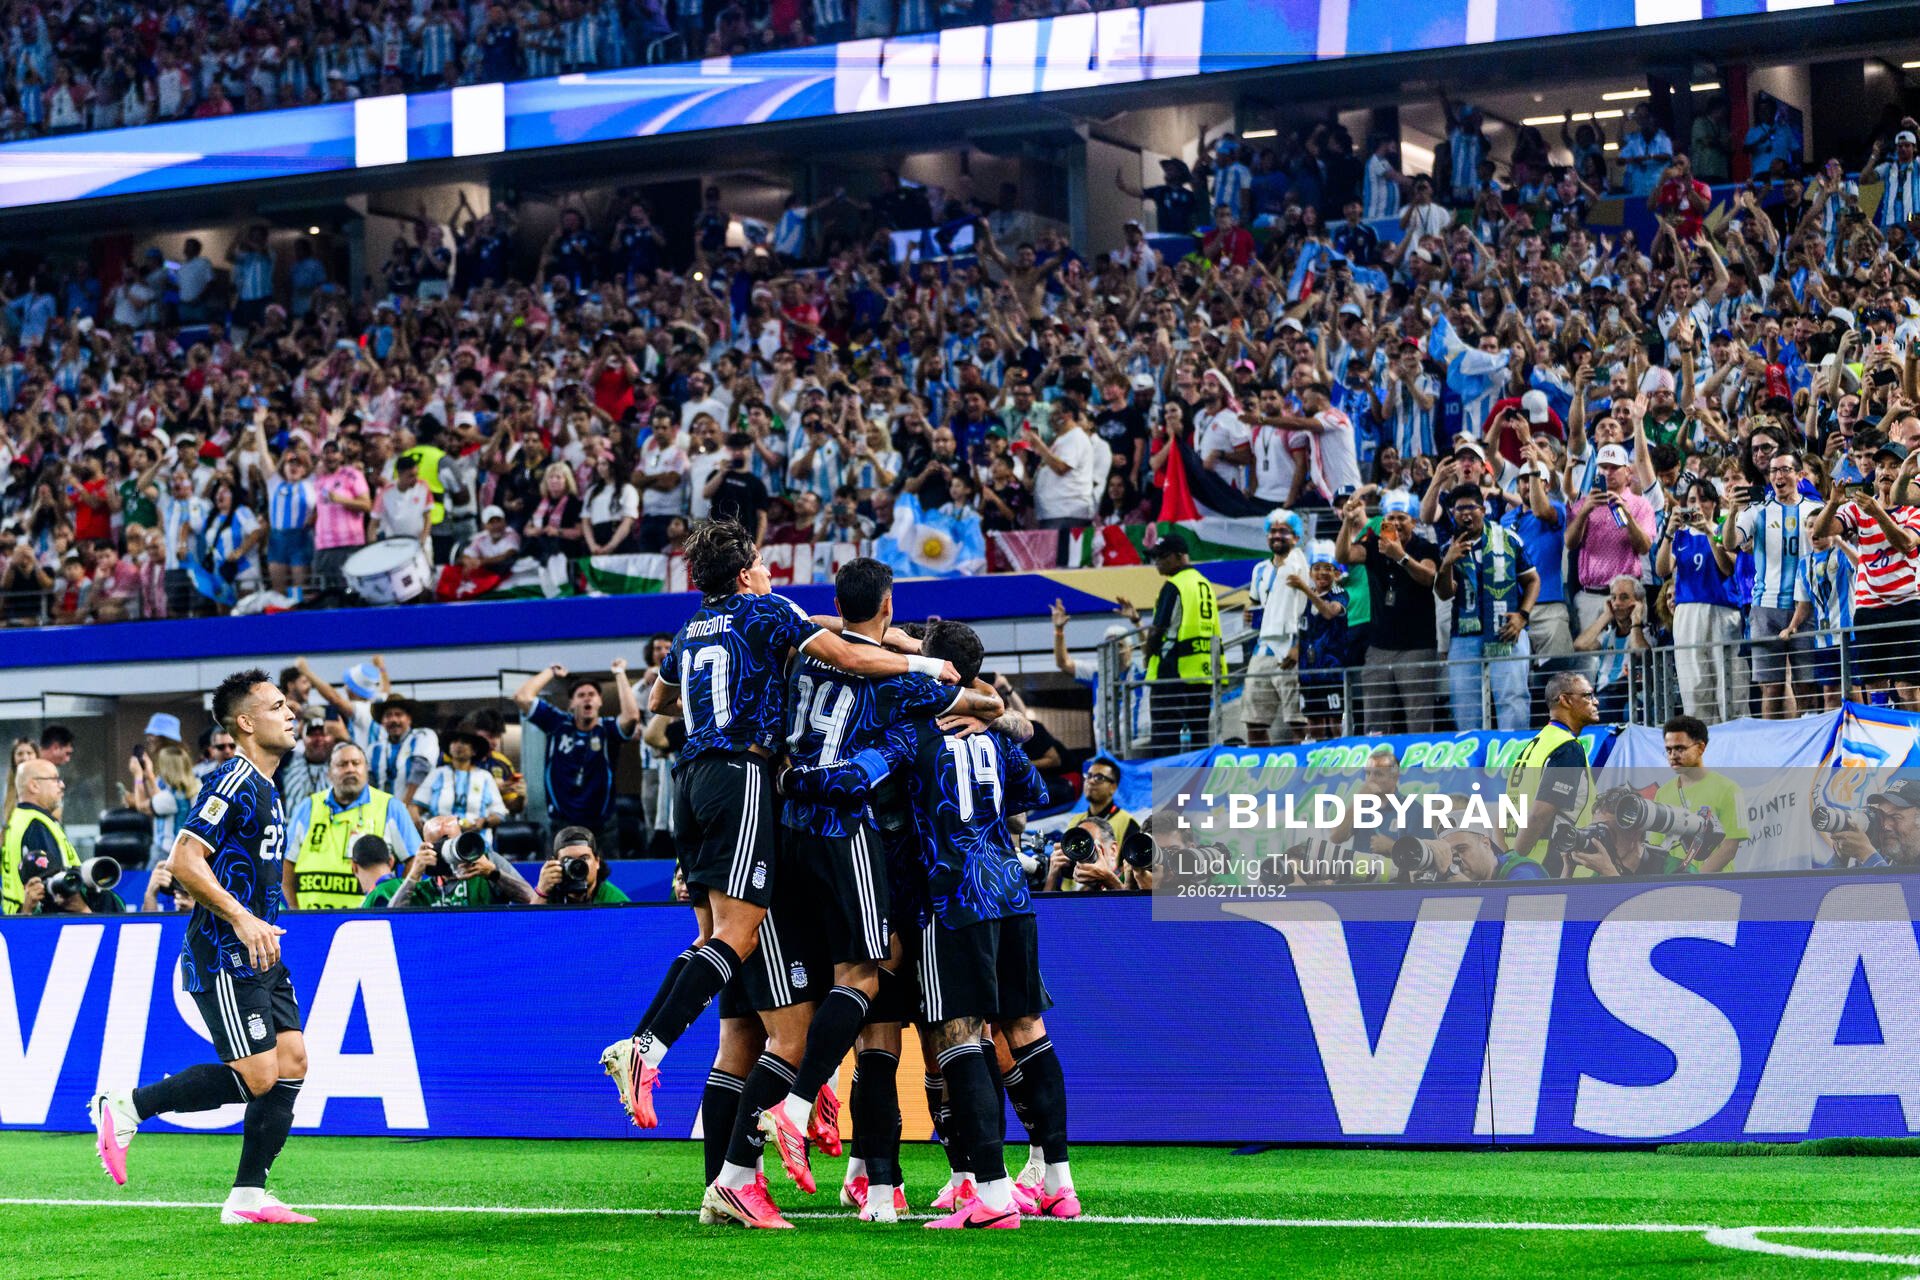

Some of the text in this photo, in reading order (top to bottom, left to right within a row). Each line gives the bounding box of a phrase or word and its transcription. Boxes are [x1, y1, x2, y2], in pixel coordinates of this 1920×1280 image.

[1693, 553, 1703, 571] 9
[1782, 536, 1799, 556] 10
[680, 644, 732, 737] 17
[785, 674, 856, 767] 14
[943, 734, 1003, 823] 19
[1202, 751, 1298, 797] DEJO
[1399, 736, 1479, 774] POR
[259, 824, 284, 861] 22
[299, 873, 358, 893] SECURIT
[1221, 883, 1920, 1138] VISA
